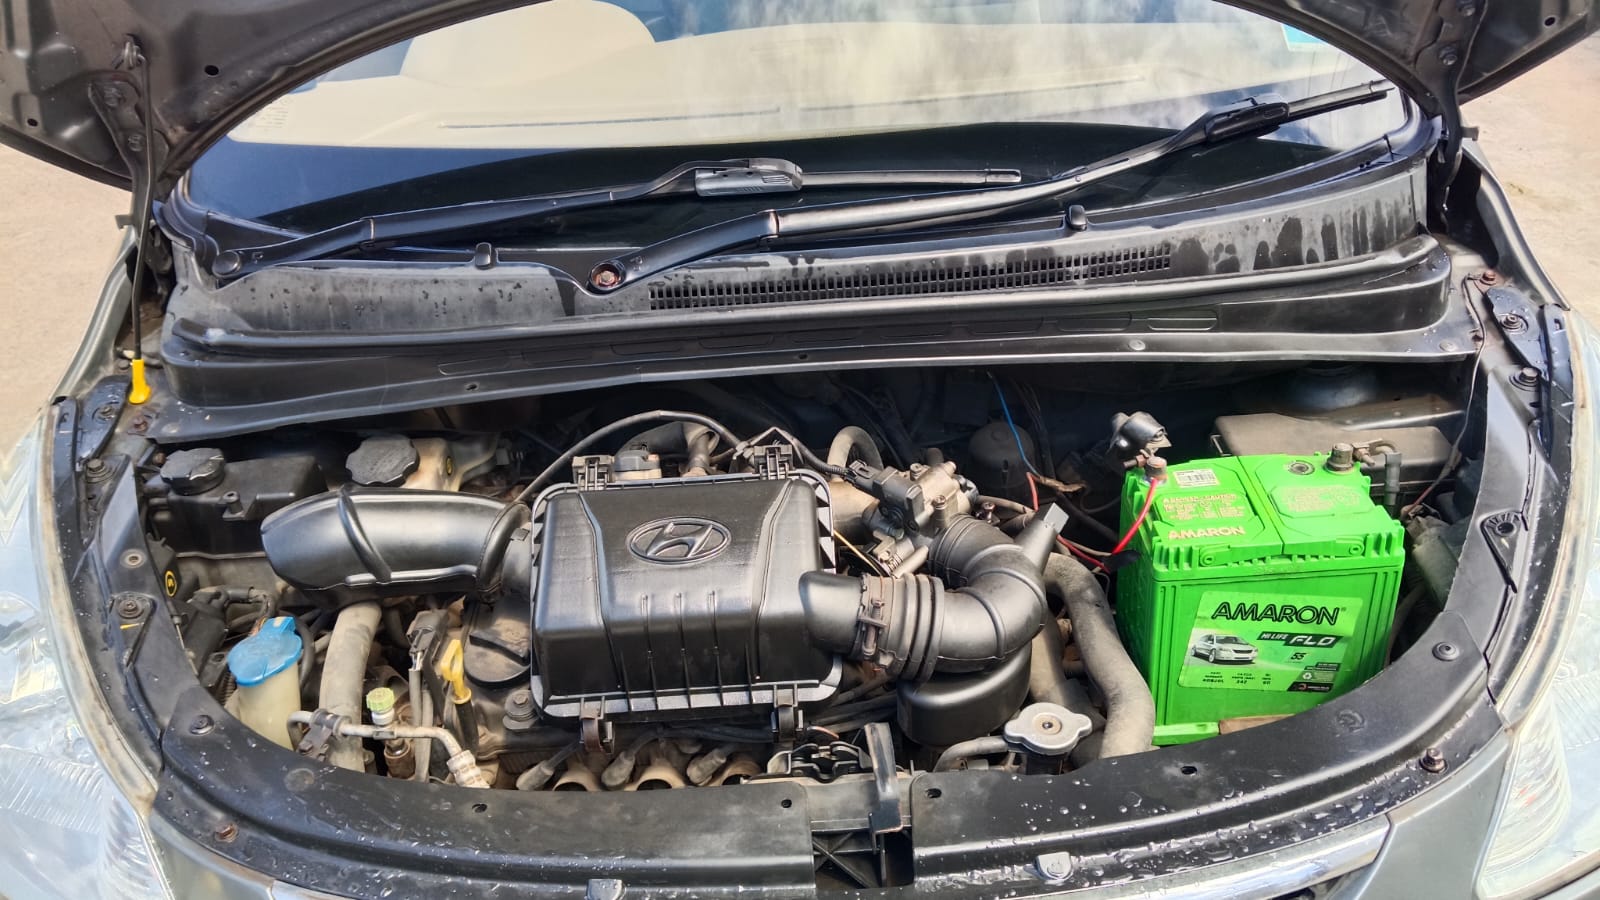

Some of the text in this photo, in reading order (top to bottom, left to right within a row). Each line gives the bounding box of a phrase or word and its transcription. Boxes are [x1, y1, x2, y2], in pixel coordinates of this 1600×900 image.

[1168, 526, 1246, 540] AMARON
[1211, 602, 1340, 625] AMARON
[1289, 635, 1336, 646] FLO
[1290, 652, 1307, 660] 55
